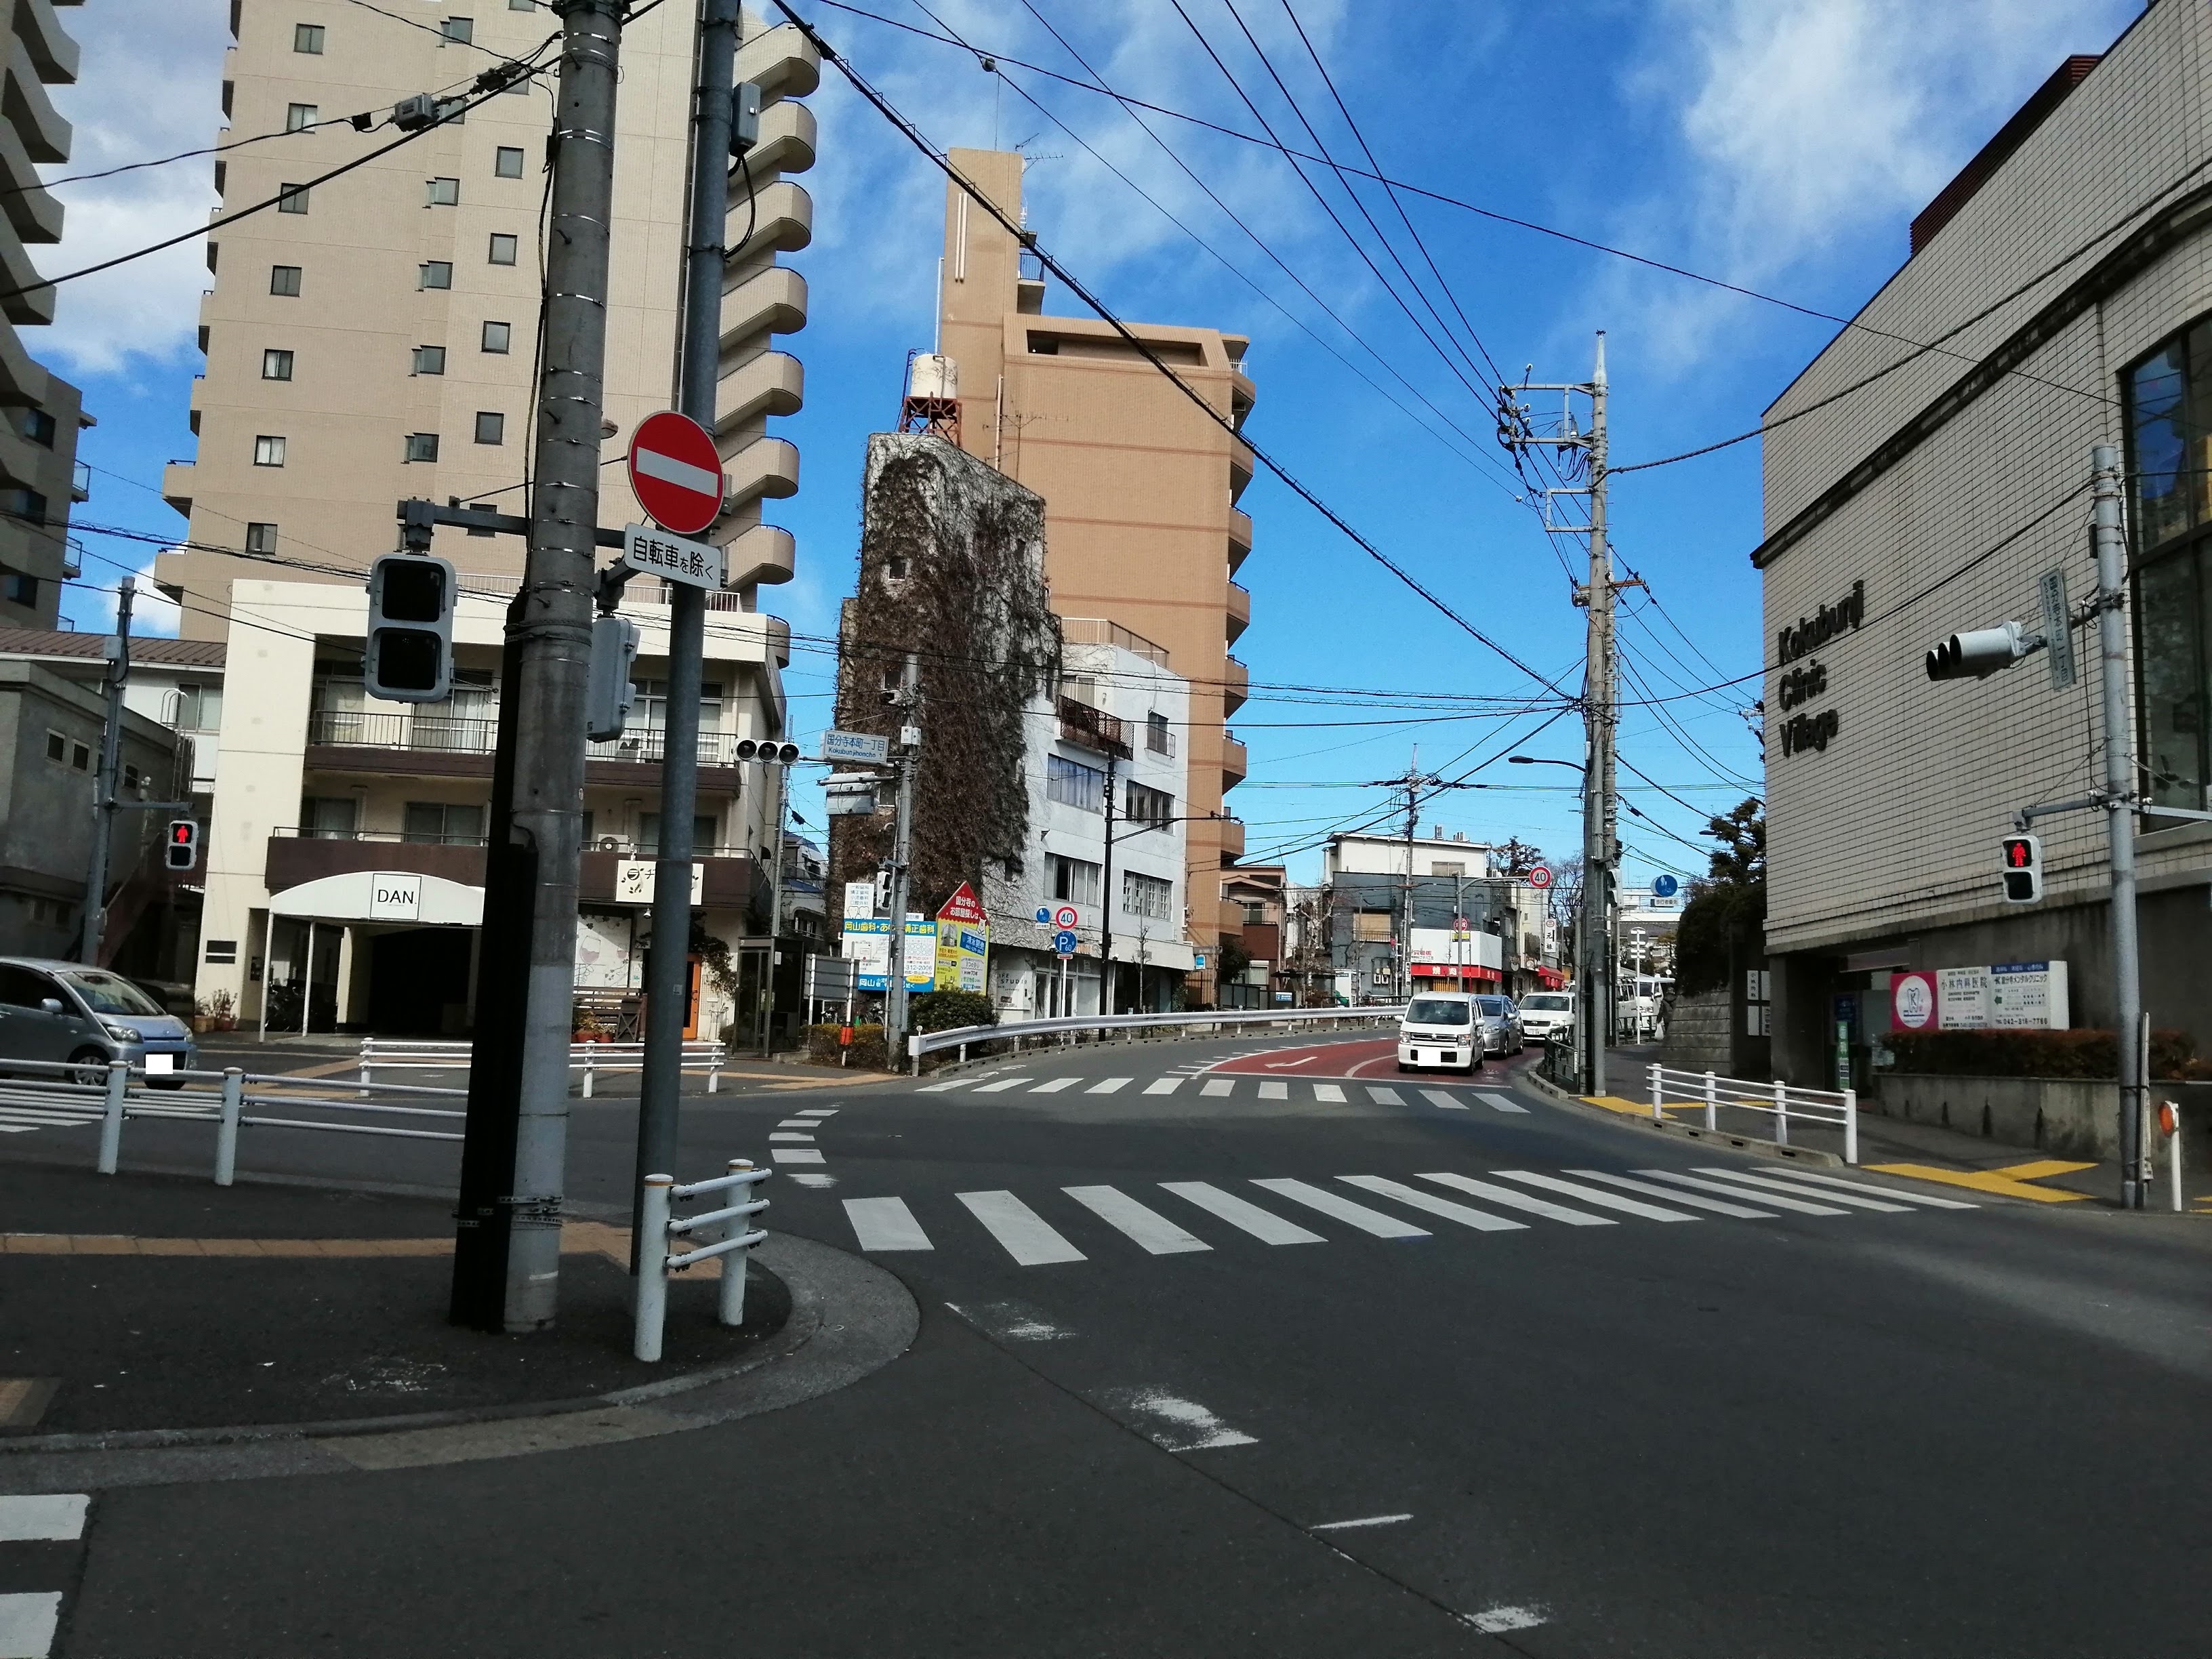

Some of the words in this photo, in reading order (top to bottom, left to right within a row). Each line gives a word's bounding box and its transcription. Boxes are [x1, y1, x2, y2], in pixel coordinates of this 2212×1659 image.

[633, 536, 713, 580] 自転車を除く
[1778, 579, 1864, 667] Kokubunji
[1779, 659, 1827, 712] Clinic
[1779, 709, 1839, 758] Village
[827, 734, 885, 752] 国分寺本町一丁目
[828, 747, 876, 758] Kokubunjihoncho
[1534, 872, 1547, 882] 40
[956, 896, 976, 907] 国分寺の
[950, 907, 979, 920] お部屋探しは
[1061, 913, 1073, 923] 40
[1059, 936, 1069, 951] P
[1432, 966, 1457, 976] 焼肉
[1941, 976, 1988, 991] 小林内科医院
